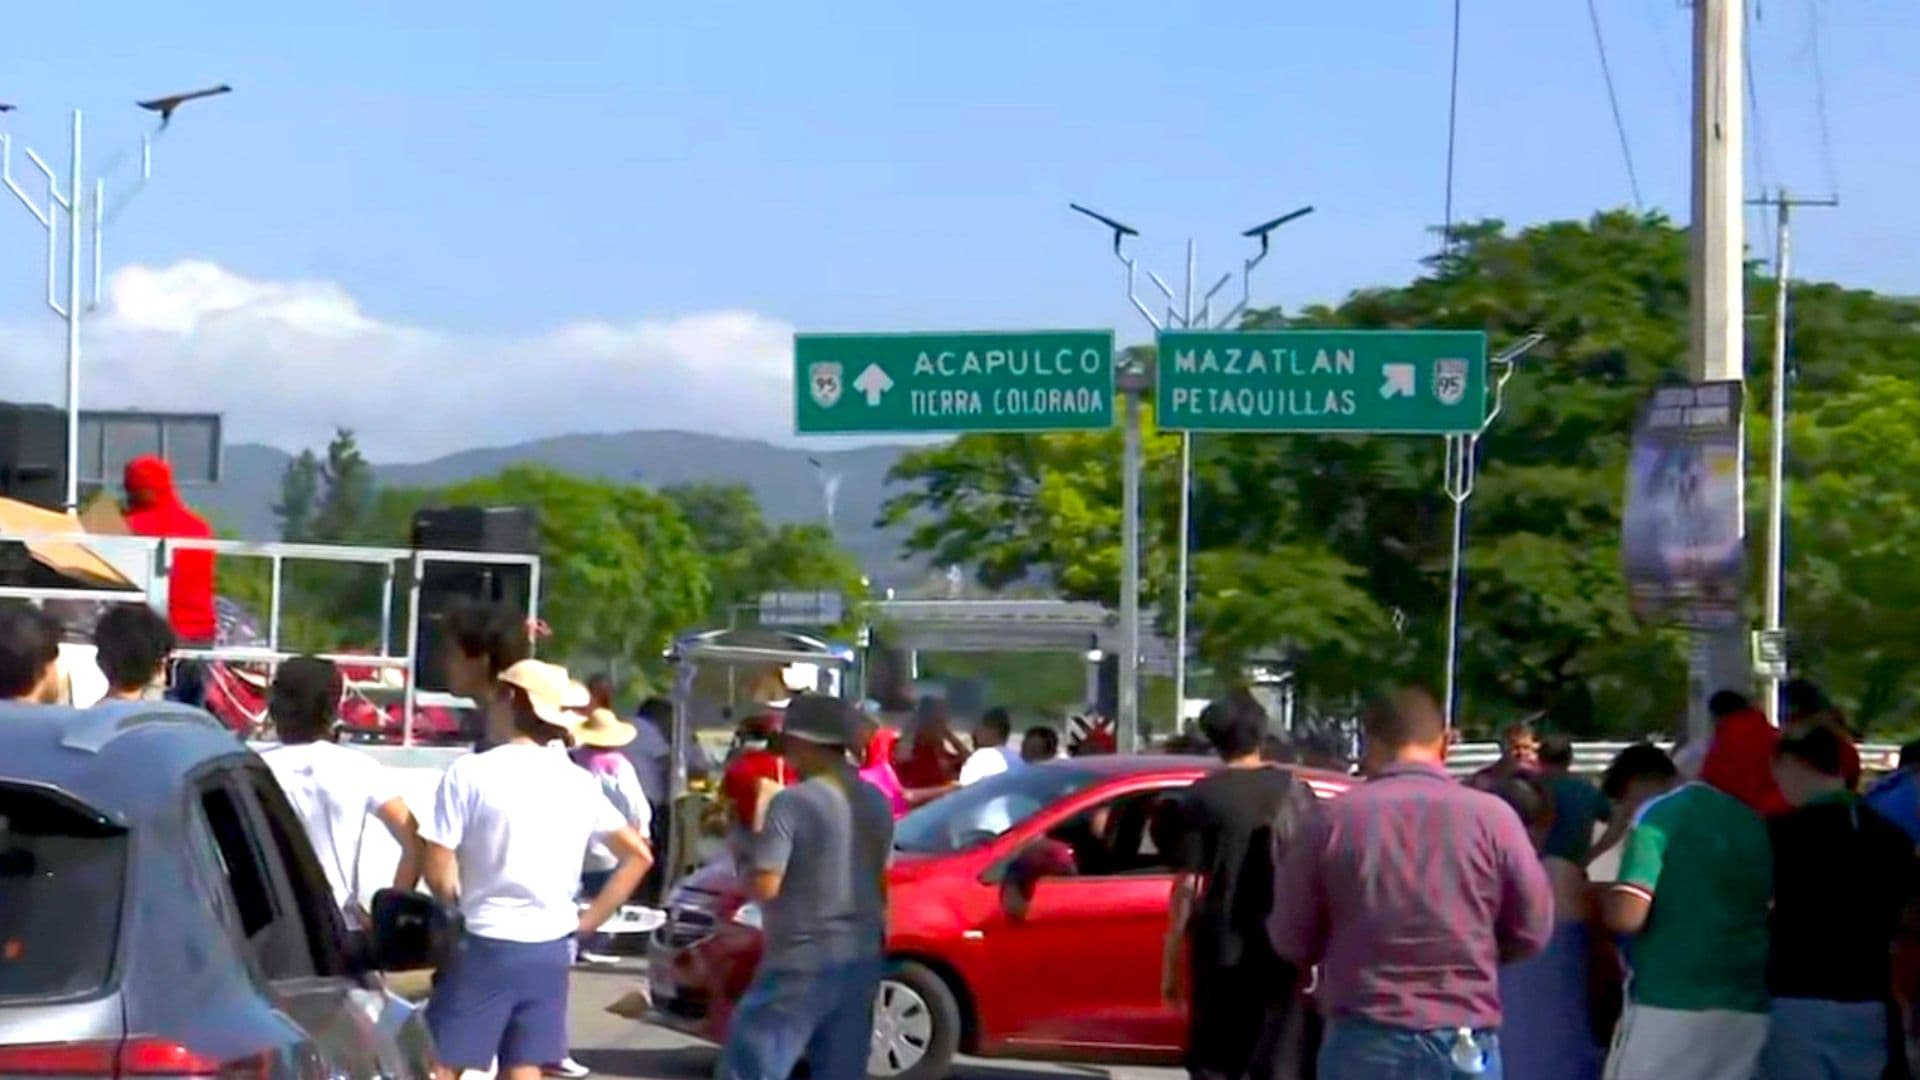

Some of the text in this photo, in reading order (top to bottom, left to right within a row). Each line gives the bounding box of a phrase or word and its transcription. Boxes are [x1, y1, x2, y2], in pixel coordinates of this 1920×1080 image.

[913, 349, 1100, 376] ACAPULCO
[1174, 348, 1355, 374] MAZATLAN
[816, 377, 837, 393] 95
[1438, 376, 1461, 395] 95
[911, 387, 1103, 416] TIERRA COLORADA
[1172, 388, 1356, 416] PETAQUILLAS
